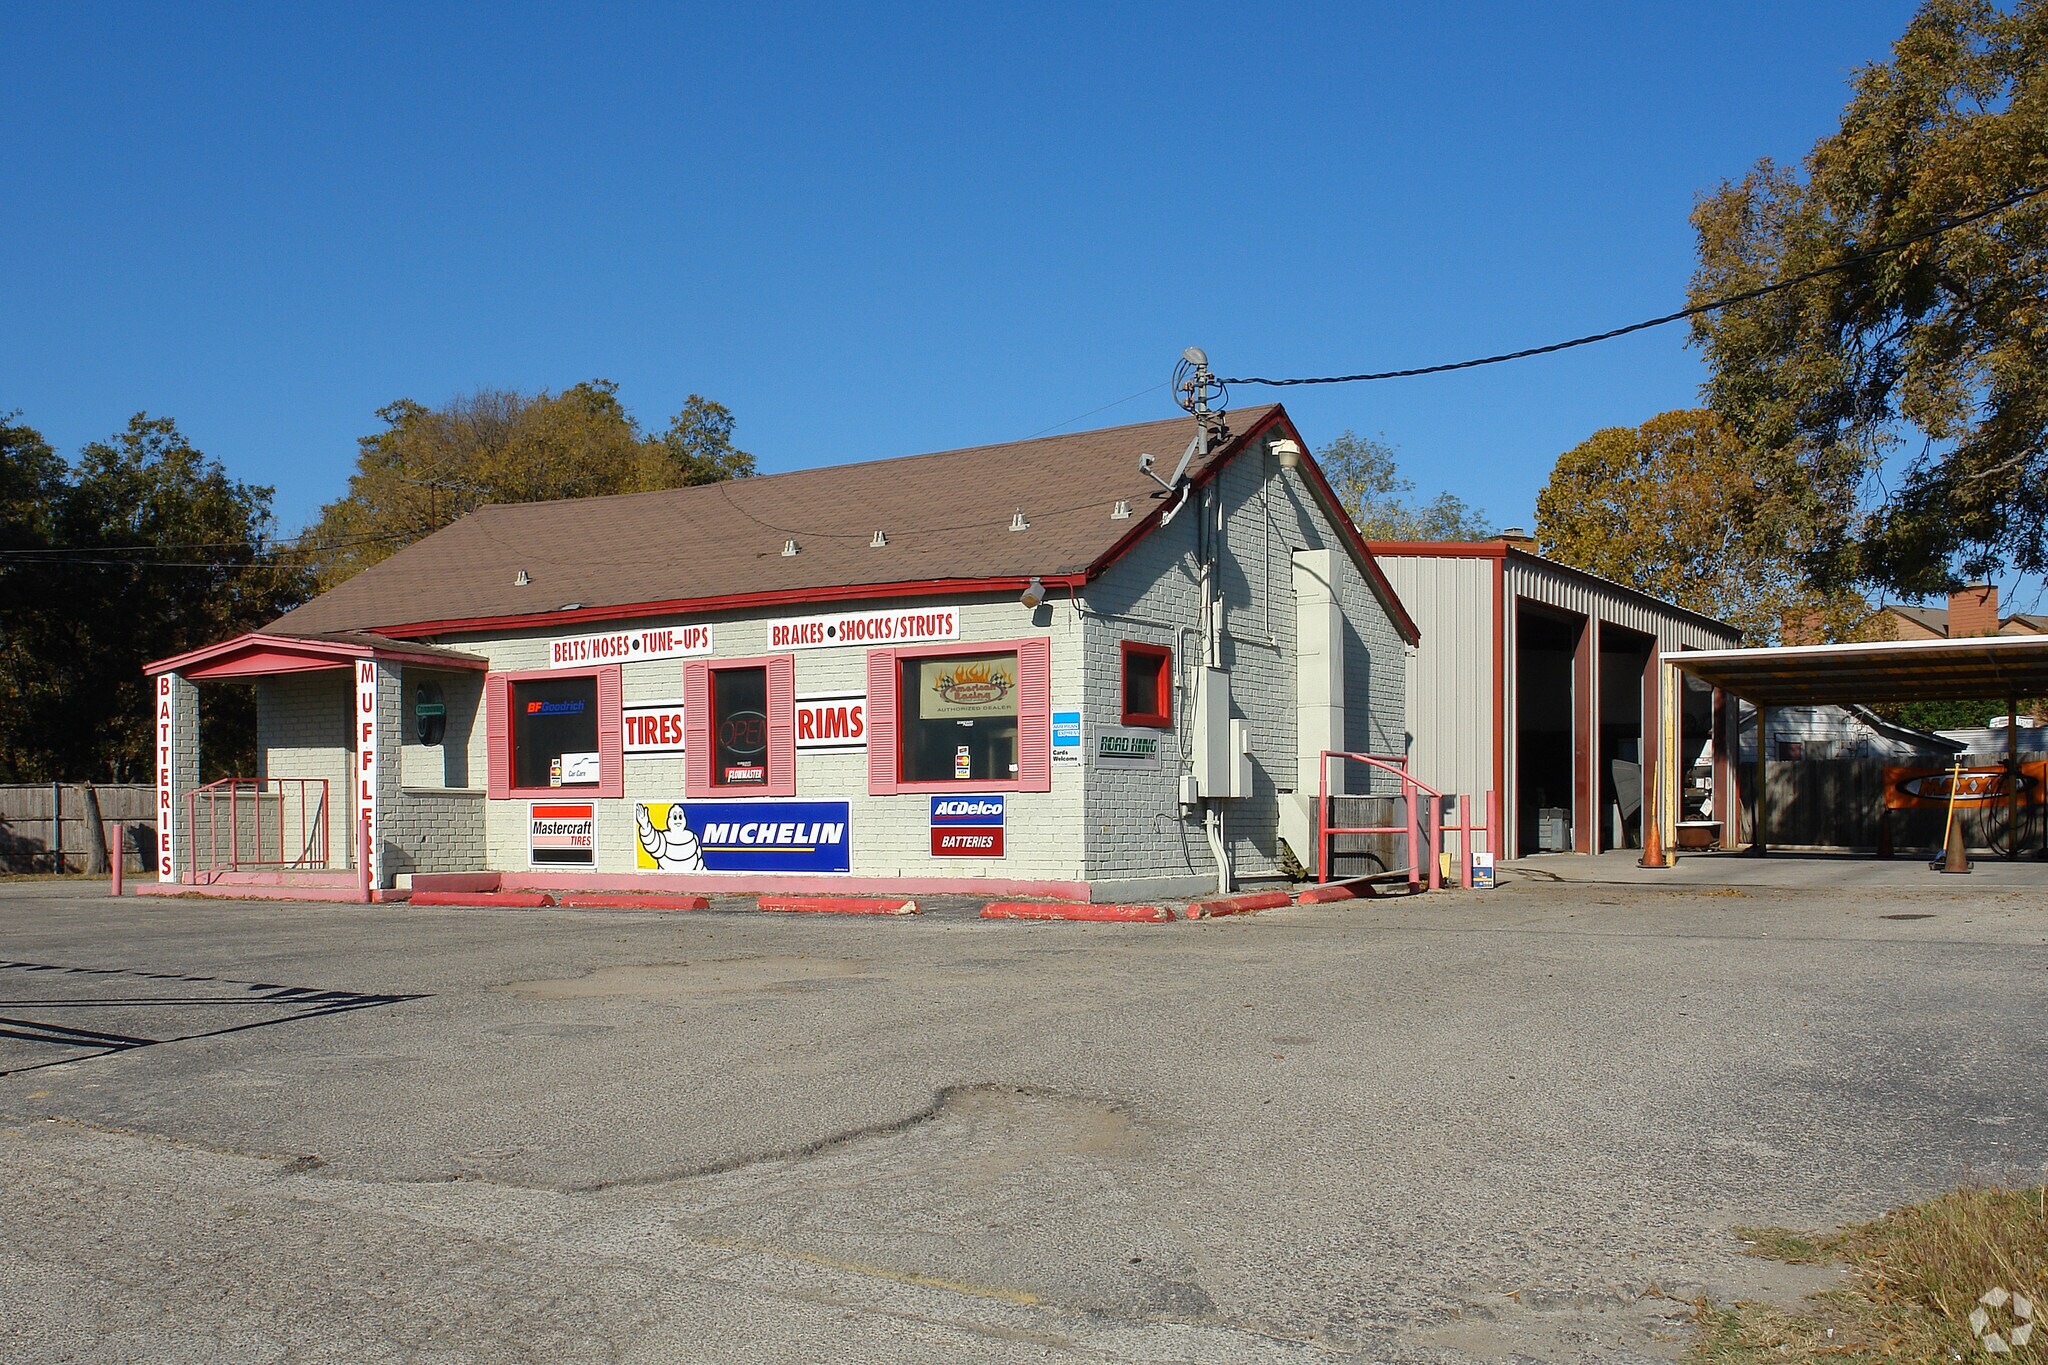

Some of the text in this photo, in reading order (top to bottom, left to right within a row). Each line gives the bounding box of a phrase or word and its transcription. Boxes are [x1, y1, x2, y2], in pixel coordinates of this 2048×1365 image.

[773, 613, 953, 646] BRAKES SHOCKS/STRUTS
[554, 626, 708, 662] BELTS/HOSES TUNE-UPS
[950, 684, 996, 693] American
[954, 691, 991, 701] Racing
[527, 700, 585, 713] BFGoodrich
[625, 713, 683, 745] TIRES
[798, 705, 864, 739] RIMS
[1100, 736, 1157, 753] ROAD KING
[160, 677, 171, 876] BATTERIES
[727, 769, 762, 783] FLOWMASTER
[934, 800, 1003, 815] ACDelco
[533, 821, 592, 835] Mastercraft
[702, 822, 845, 844] MICHELIN
[570, 835, 592, 846] TIRES
[941, 835, 994, 848] BATTERIES
